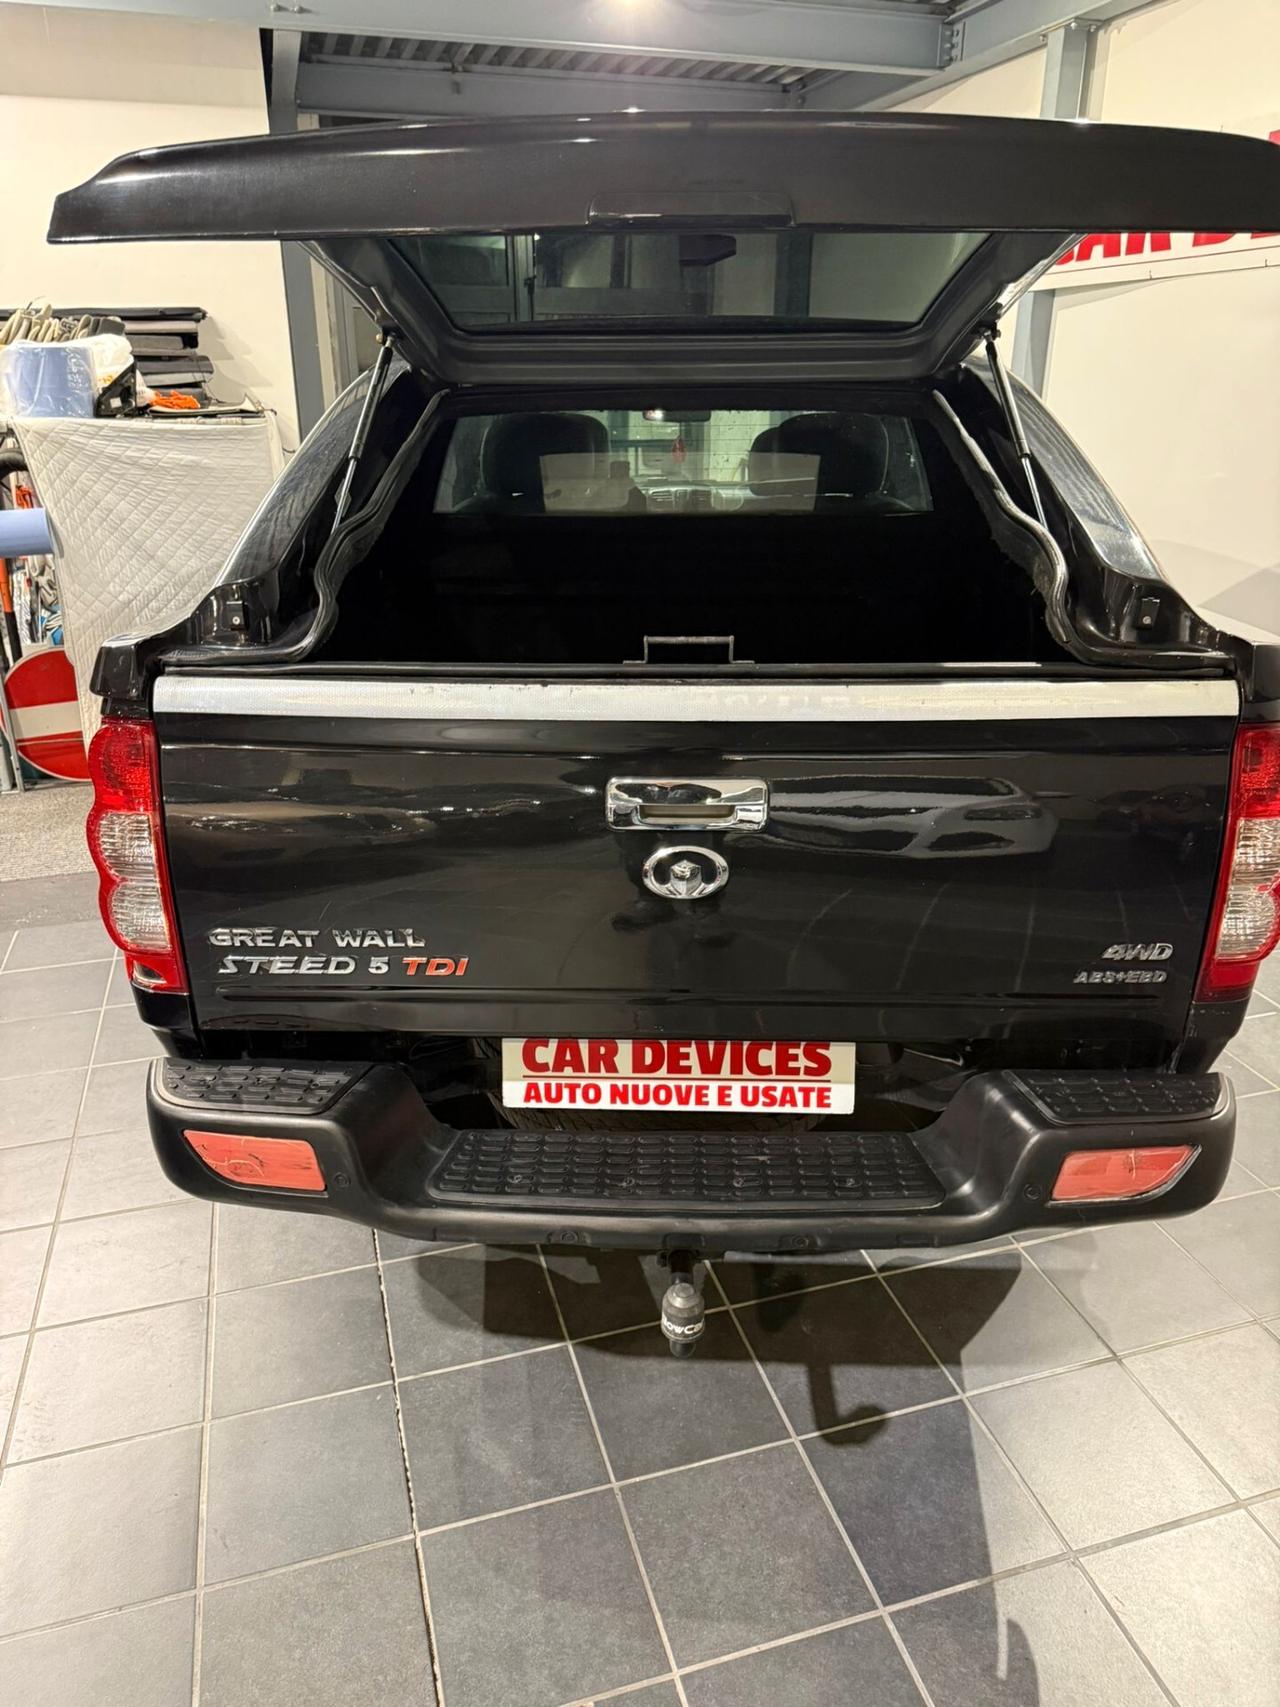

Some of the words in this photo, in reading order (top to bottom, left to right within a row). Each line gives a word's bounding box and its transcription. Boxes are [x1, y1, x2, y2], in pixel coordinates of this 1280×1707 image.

[208, 927, 319, 948] GREAT
[332, 928, 425, 948] WALL
[1102, 943, 1174, 961] 4WD
[218, 955, 356, 975] STEED
[368, 956, 389, 974] 5
[402, 957, 469, 976] TDI
[1073, 970, 1167, 984] ABS+EBD
[521, 1038, 620, 1075] CAR
[631, 1038, 832, 1077] DEVICES
[523, 1082, 602, 1104] AUTO
[610, 1083, 710, 1107] NUOVE
[717, 1085, 733, 1107] E
[740, 1086, 832, 1109] USATE
